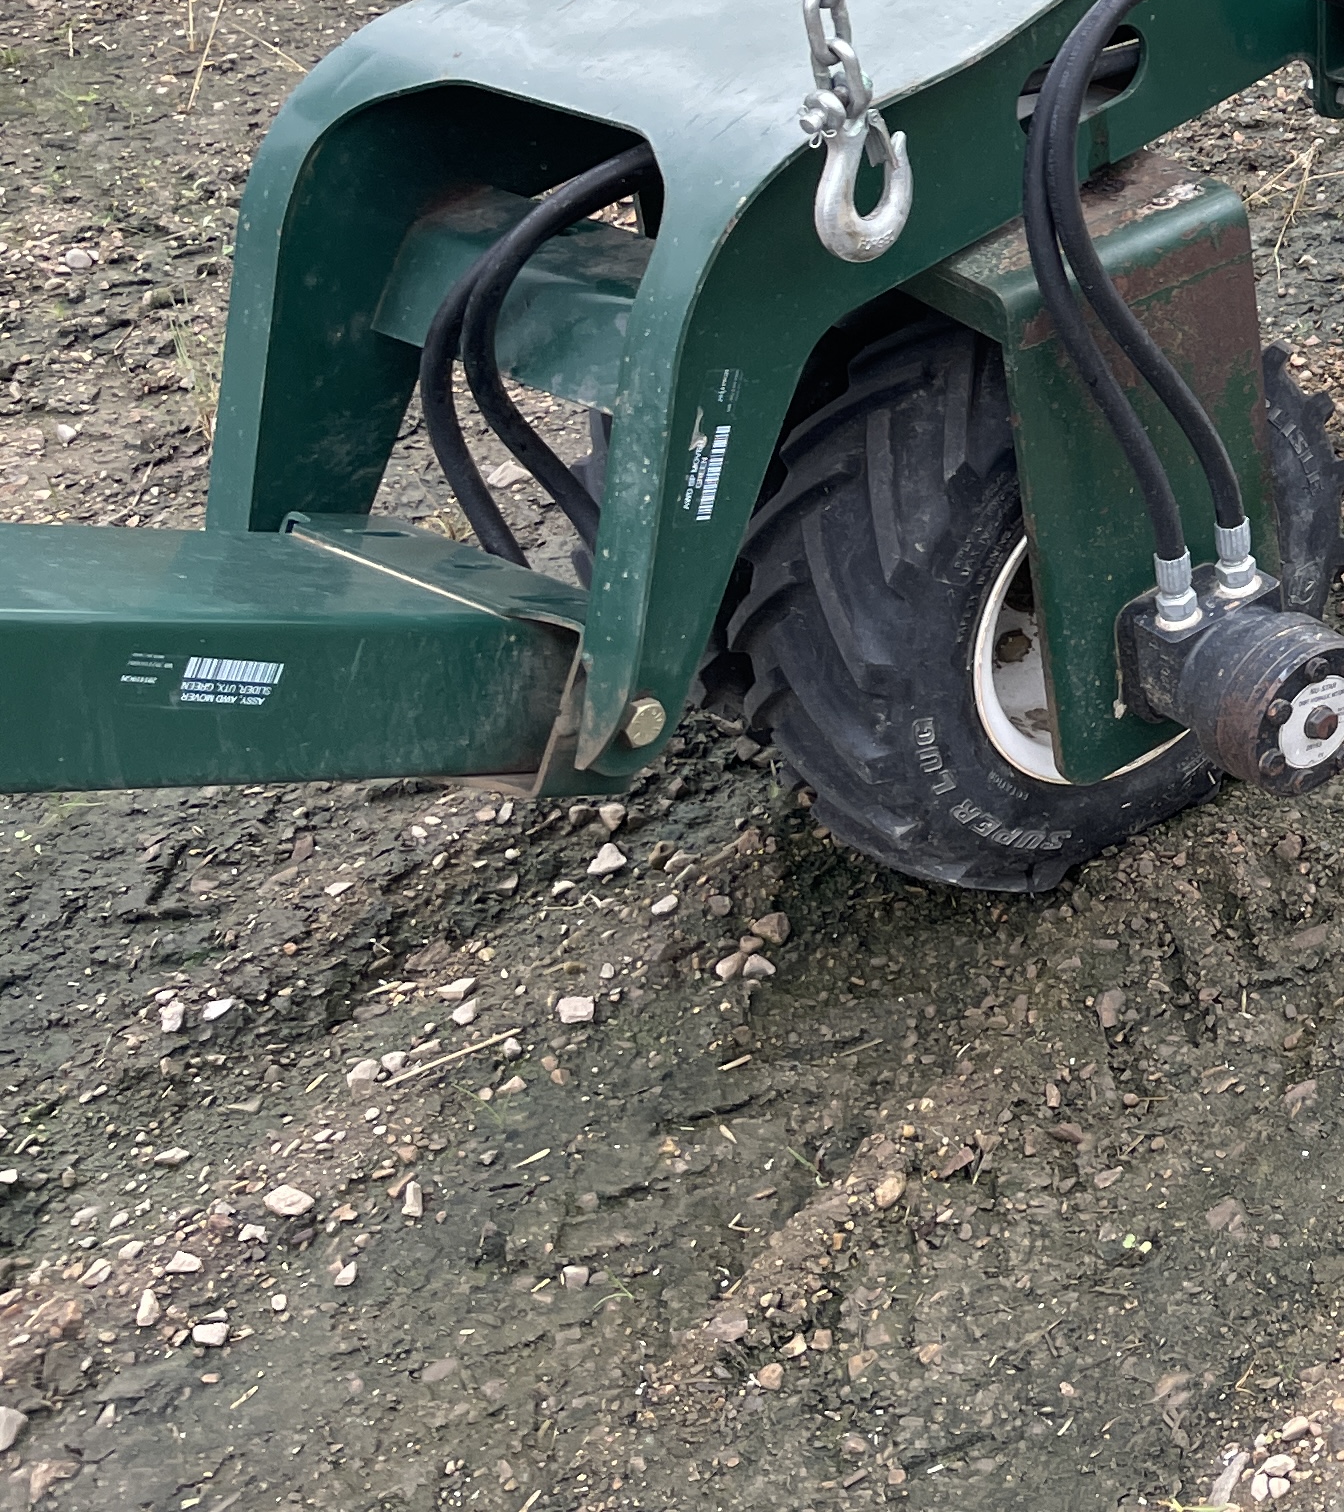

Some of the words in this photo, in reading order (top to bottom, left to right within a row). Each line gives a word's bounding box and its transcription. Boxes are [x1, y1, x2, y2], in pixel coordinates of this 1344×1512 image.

[180, 681, 215, 691] GREEN
[239, 685, 273, 696] SLIDER,
[180, 692, 214, 703] MOVER
[239, 696, 266, 706] ASSY,
[911, 716, 958, 796] LUG
[949, 797, 1073, 851] SUPER
